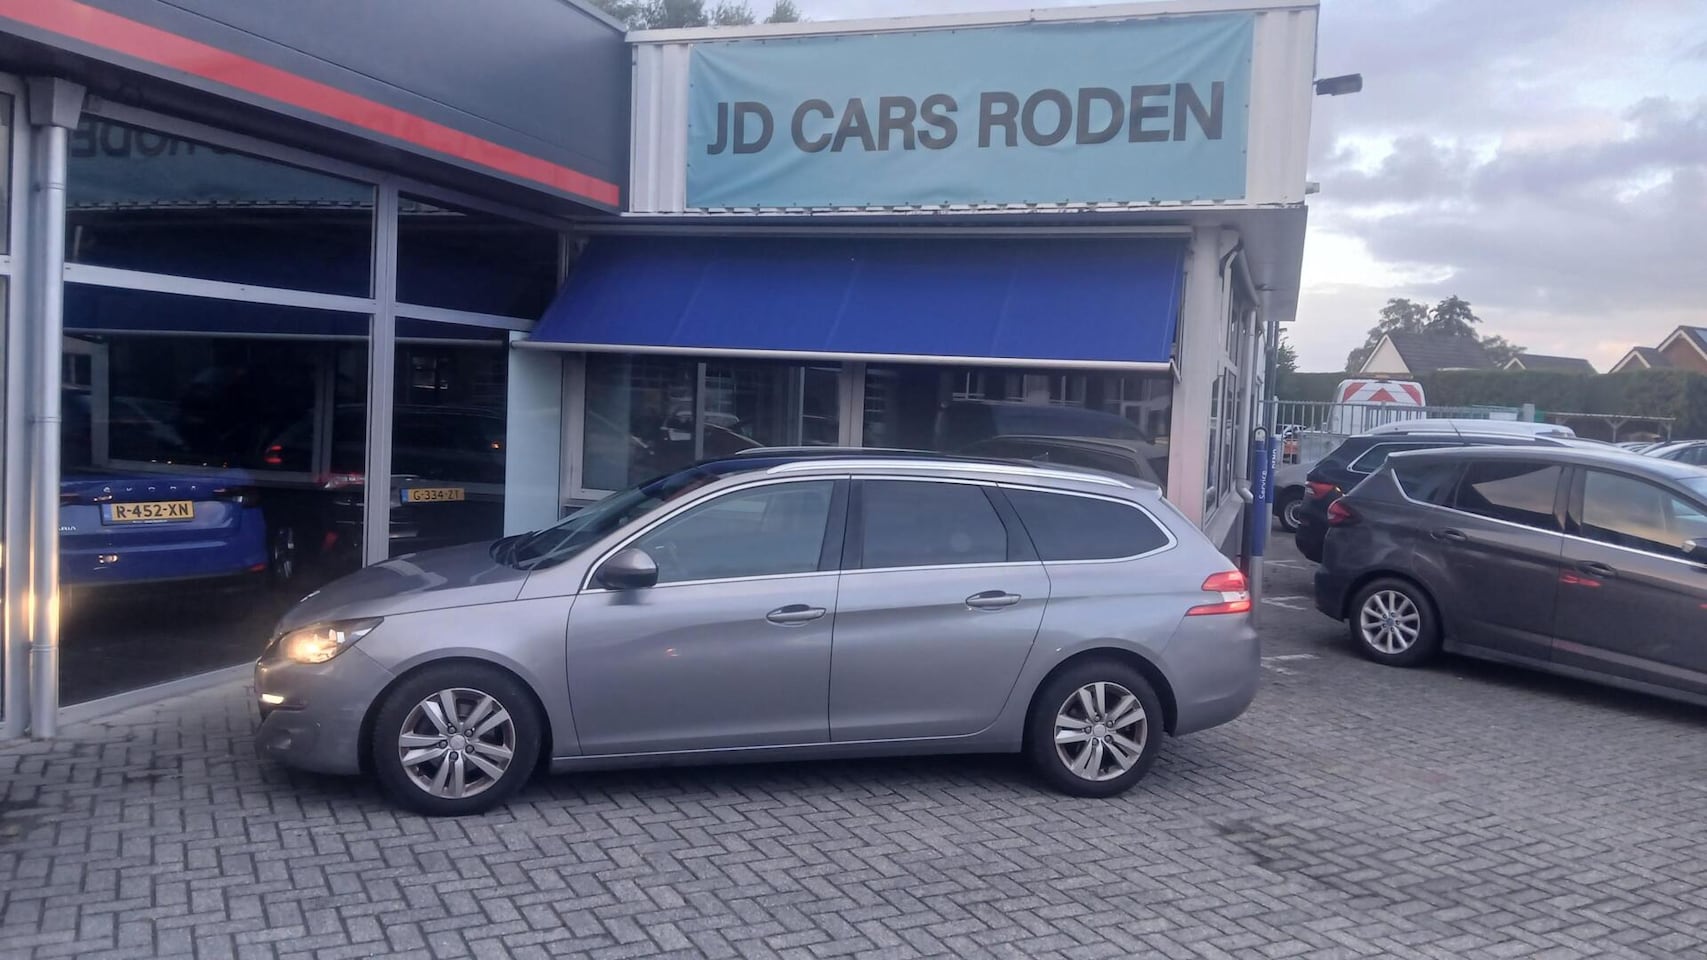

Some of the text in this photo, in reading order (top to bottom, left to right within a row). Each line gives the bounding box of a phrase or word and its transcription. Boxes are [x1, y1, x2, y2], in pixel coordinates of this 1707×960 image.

[707, 81, 1225, 155] JD CARS RODEN
[1258, 470, 1267, 499] Service
[116, 503, 189, 518] R-452-XN
